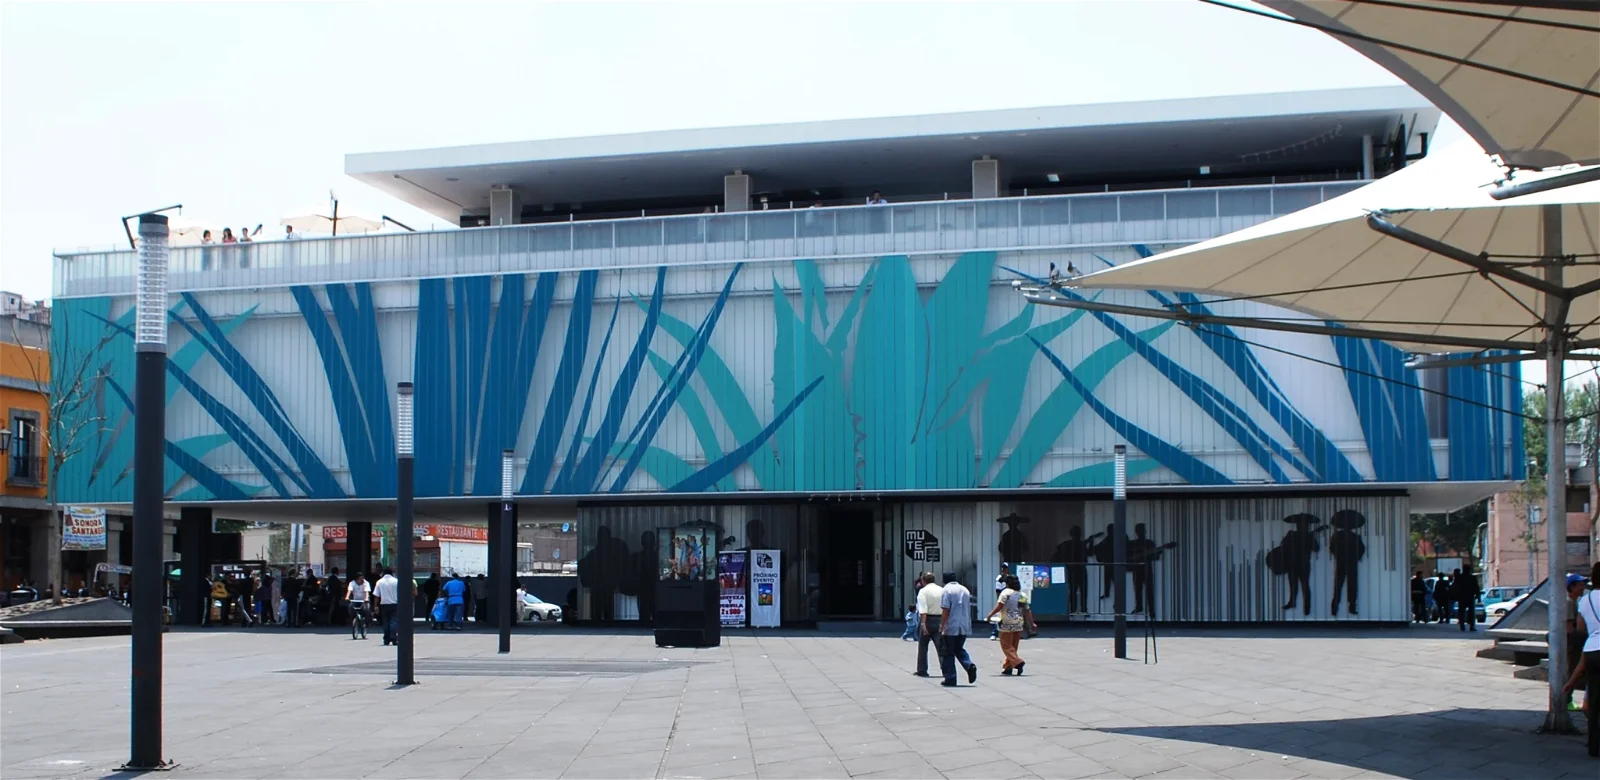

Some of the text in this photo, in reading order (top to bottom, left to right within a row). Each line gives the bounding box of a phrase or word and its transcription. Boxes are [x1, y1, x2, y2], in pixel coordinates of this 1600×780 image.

[906, 531, 925, 540] MU
[906, 541, 922, 550] TE
[914, 550, 924, 559] M
